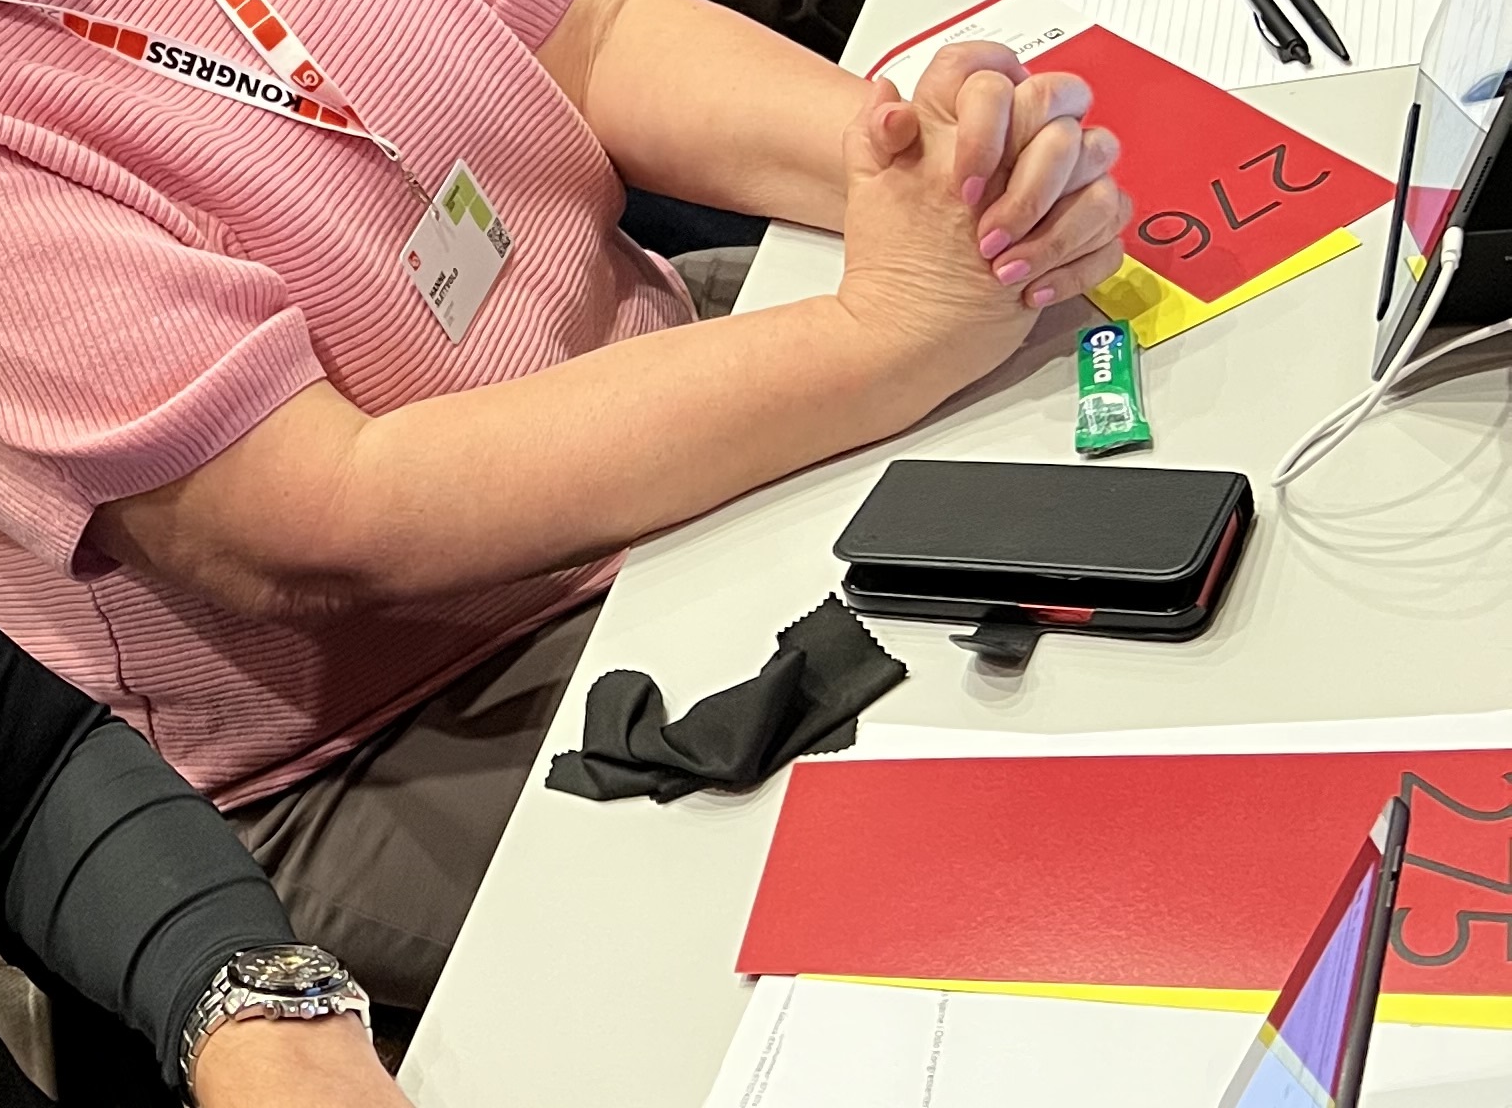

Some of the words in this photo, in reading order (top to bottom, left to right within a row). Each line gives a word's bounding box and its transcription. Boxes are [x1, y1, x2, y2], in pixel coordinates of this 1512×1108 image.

[146, 41, 302, 112] KONGRESS
[1138, 143, 1331, 260] 276
[1390, 771, 1512, 966] 275
